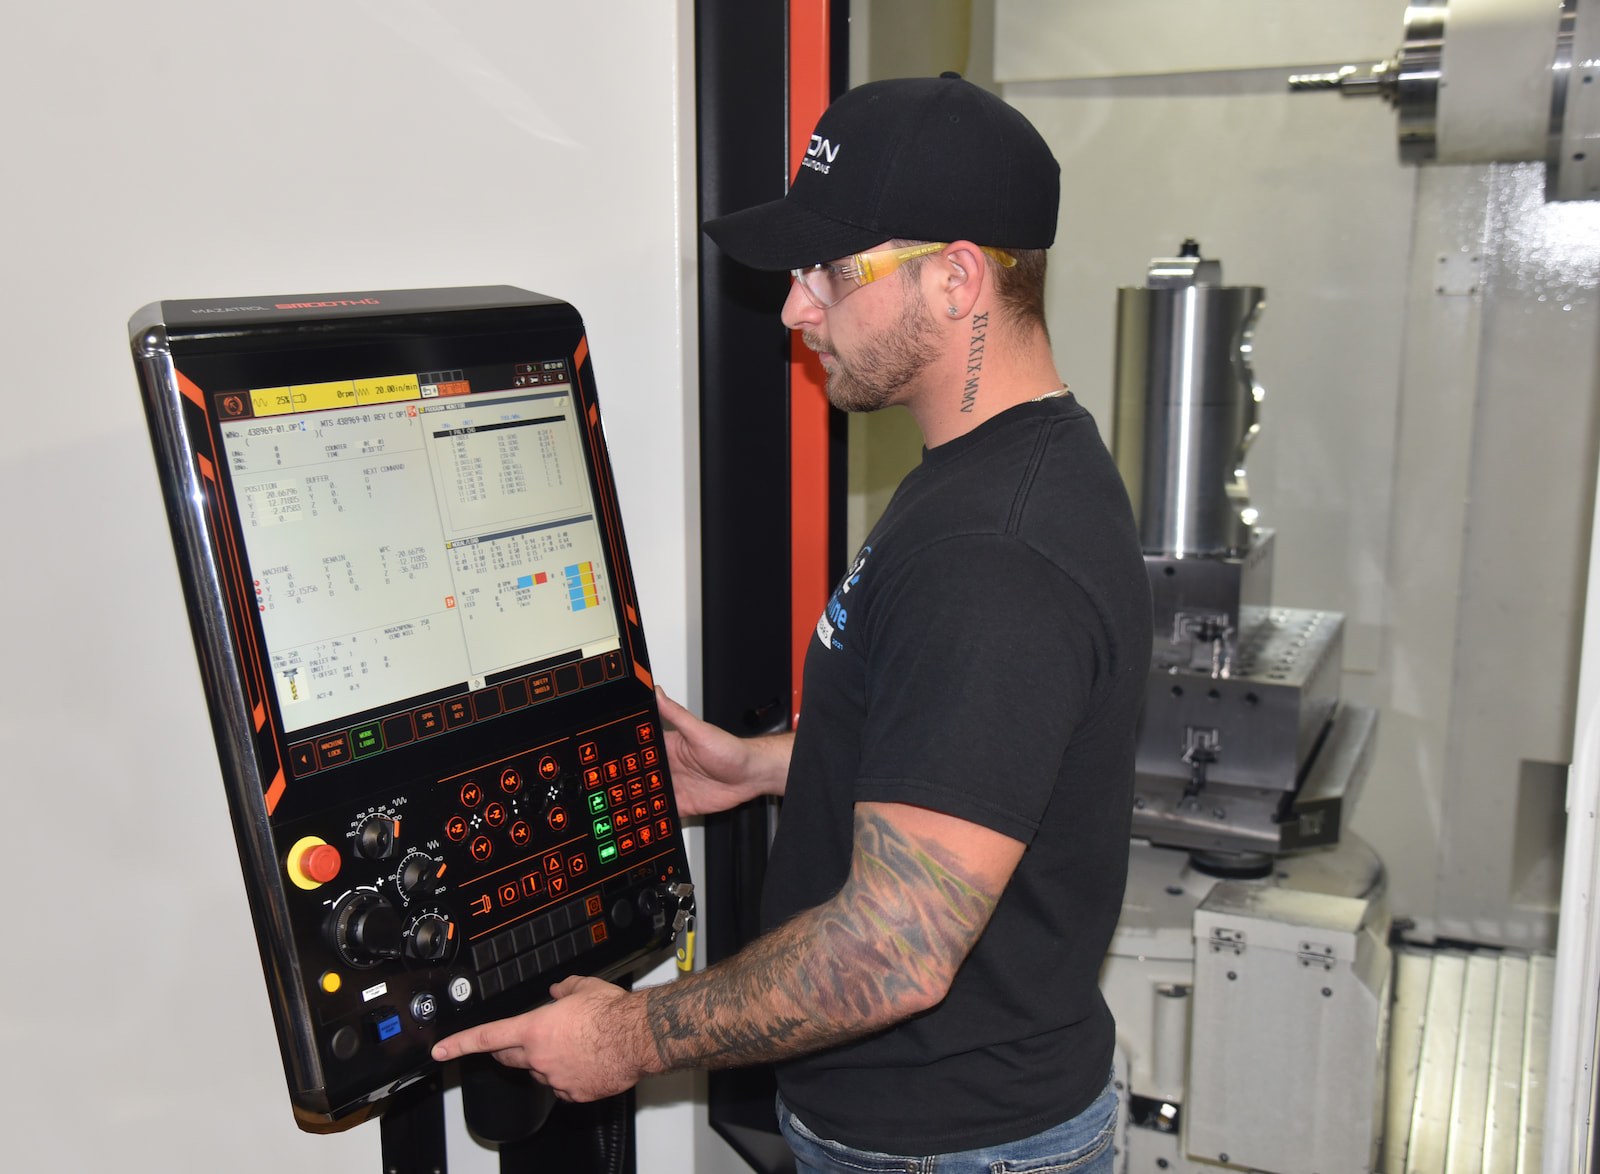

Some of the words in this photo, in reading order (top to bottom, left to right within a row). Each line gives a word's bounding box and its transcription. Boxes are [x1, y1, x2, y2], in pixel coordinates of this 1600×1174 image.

[192, 306, 270, 314] MAZATROL
[375, 383, 418, 394] 20.00in/min
[336, 390, 354, 400] 0rpm
[276, 396, 291, 406] 25%
[374, 412, 386, 421] REV
[305, 475, 330, 484] BUFFER
[244, 482, 277, 493] POSITION
[322, 555, 346, 564] REMAIN
[262, 565, 289, 576] MACHINE
[533, 677, 548, 686] SAFETY
[359, 730, 373, 739] WORK
[321, 738, 344, 750] MACHINE
[359, 738, 375, 748] LIGHT
[328, 748, 342, 758] LOCK
[542, 763, 554, 773] +B
[504, 775, 516, 785] +X
[466, 790, 477, 799] +Y
[489, 809, 501, 819] -Z
[552, 813, 564, 823] -B
[451, 823, 463, 834] +Z
[515, 828, 526, 837] -X
[476, 843, 487, 852] -Y
[435, 886, 446, 894] 200
